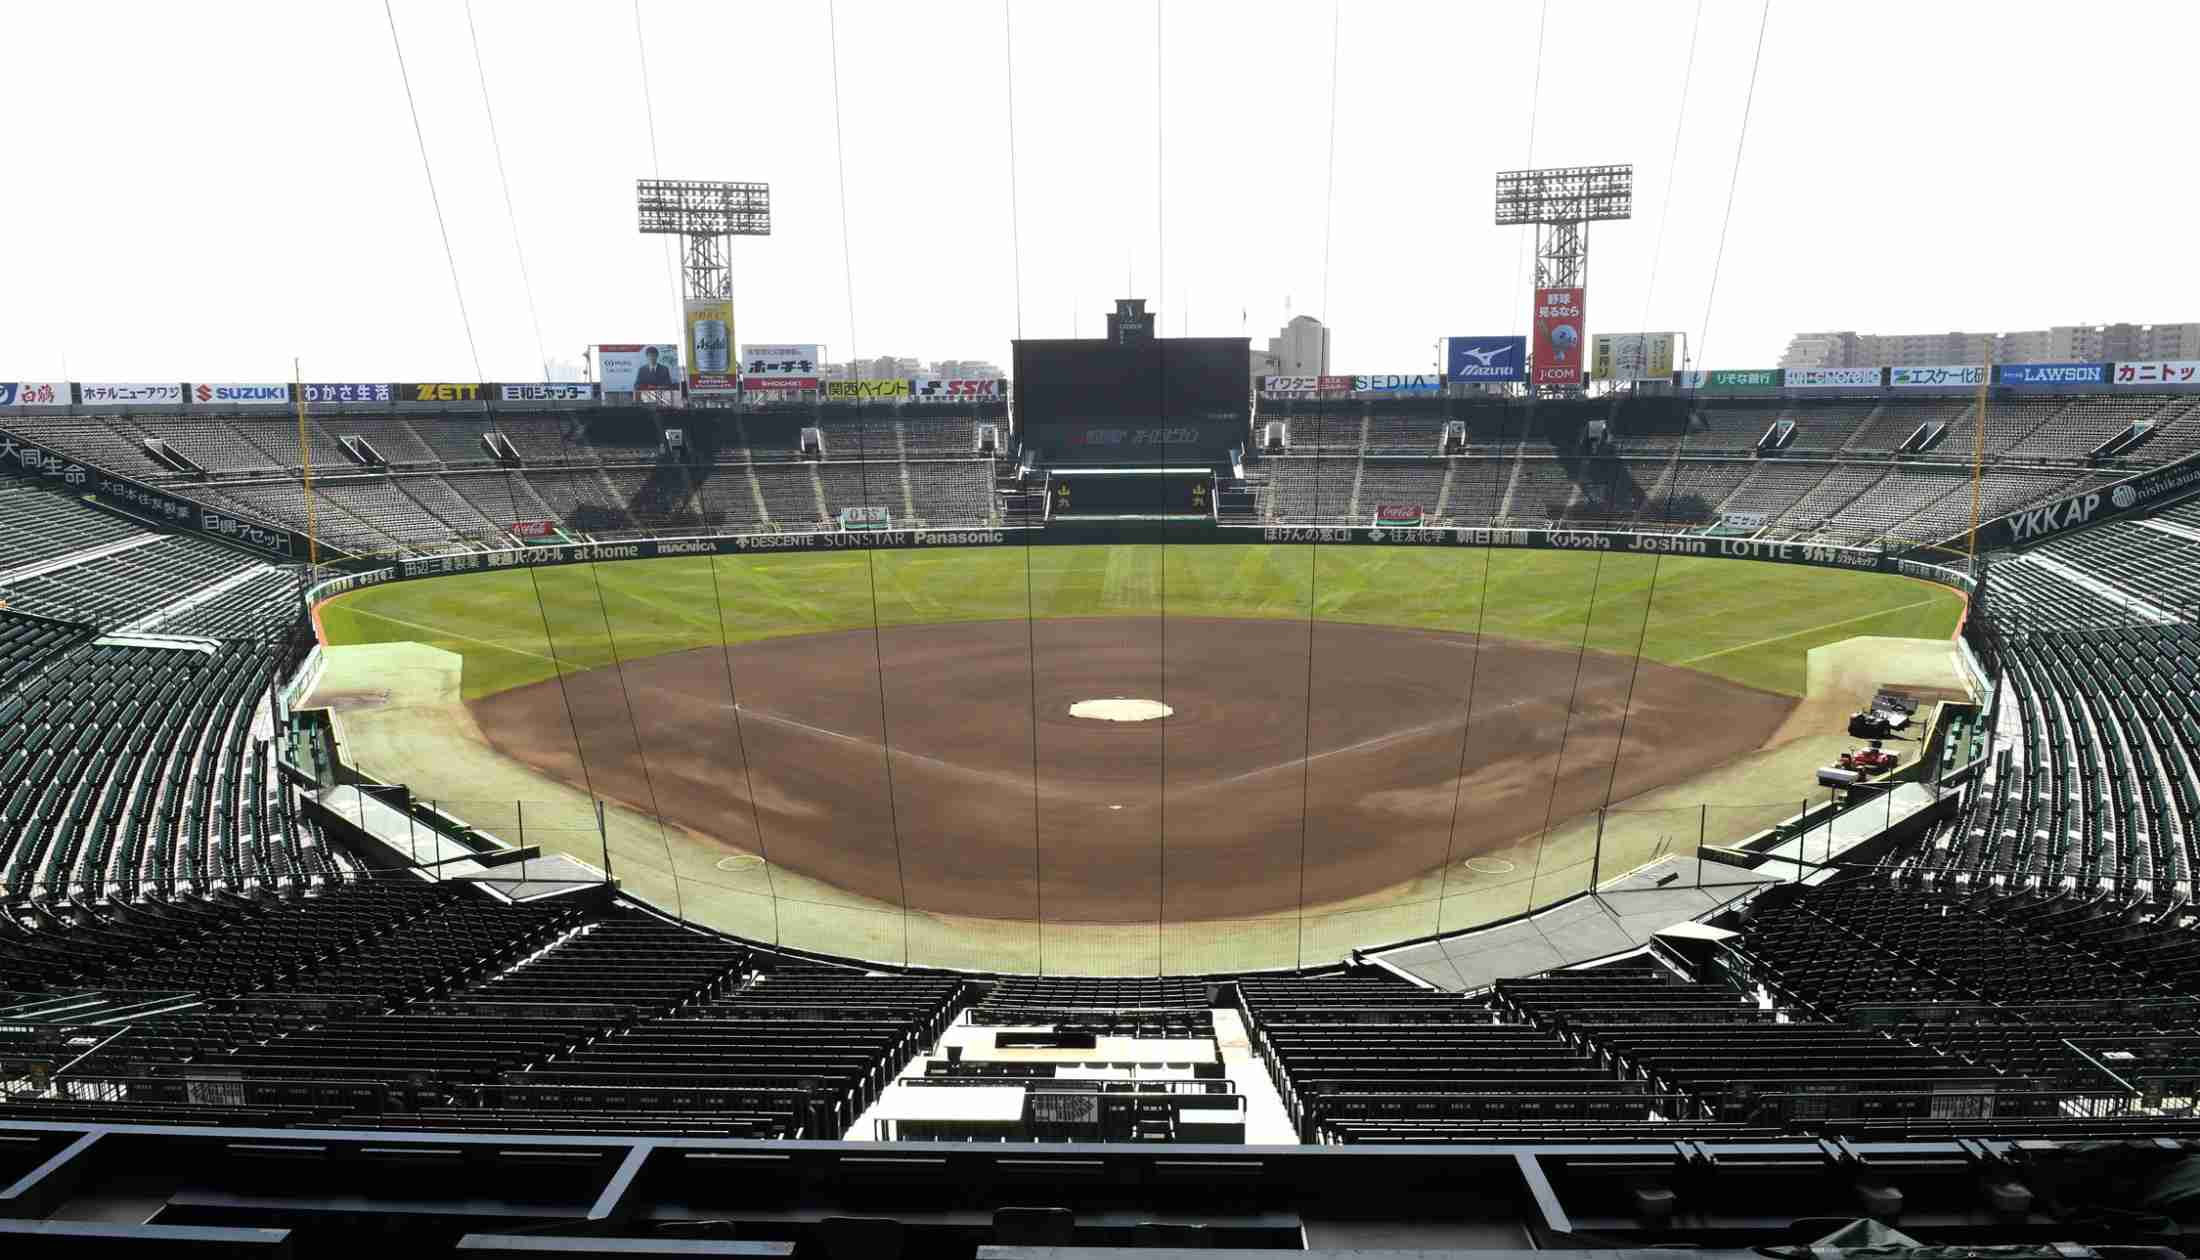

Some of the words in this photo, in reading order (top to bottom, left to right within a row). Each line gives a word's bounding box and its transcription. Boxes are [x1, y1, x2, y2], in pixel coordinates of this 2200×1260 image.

[2024, 367, 2101, 381] LAWSON
[828, 381, 909, 396] 関西ペイント
[947, 381, 993, 395] SSK
[1267, 377, 1316, 390] イワタニ
[1354, 375, 1427, 389] SEDIA
[83, 387, 181, 400] ホテルニューアワジ
[216, 387, 285, 399] SUZUKI
[303, 384, 390, 400] わかさ生活
[416, 384, 479, 400] ZETT
[0, 438, 88, 486] 大同生命
[2008, 508, 2063, 542] YKK
[2063, 494, 2101, 527] AP
[751, 535, 815, 547] DESCENTE
[824, 532, 907, 546] SUNSTAR
[913, 530, 1004, 545] Panasonic
[1628, 534, 1706, 552] Joshin
[1720, 539, 1793, 559] LOTTE
